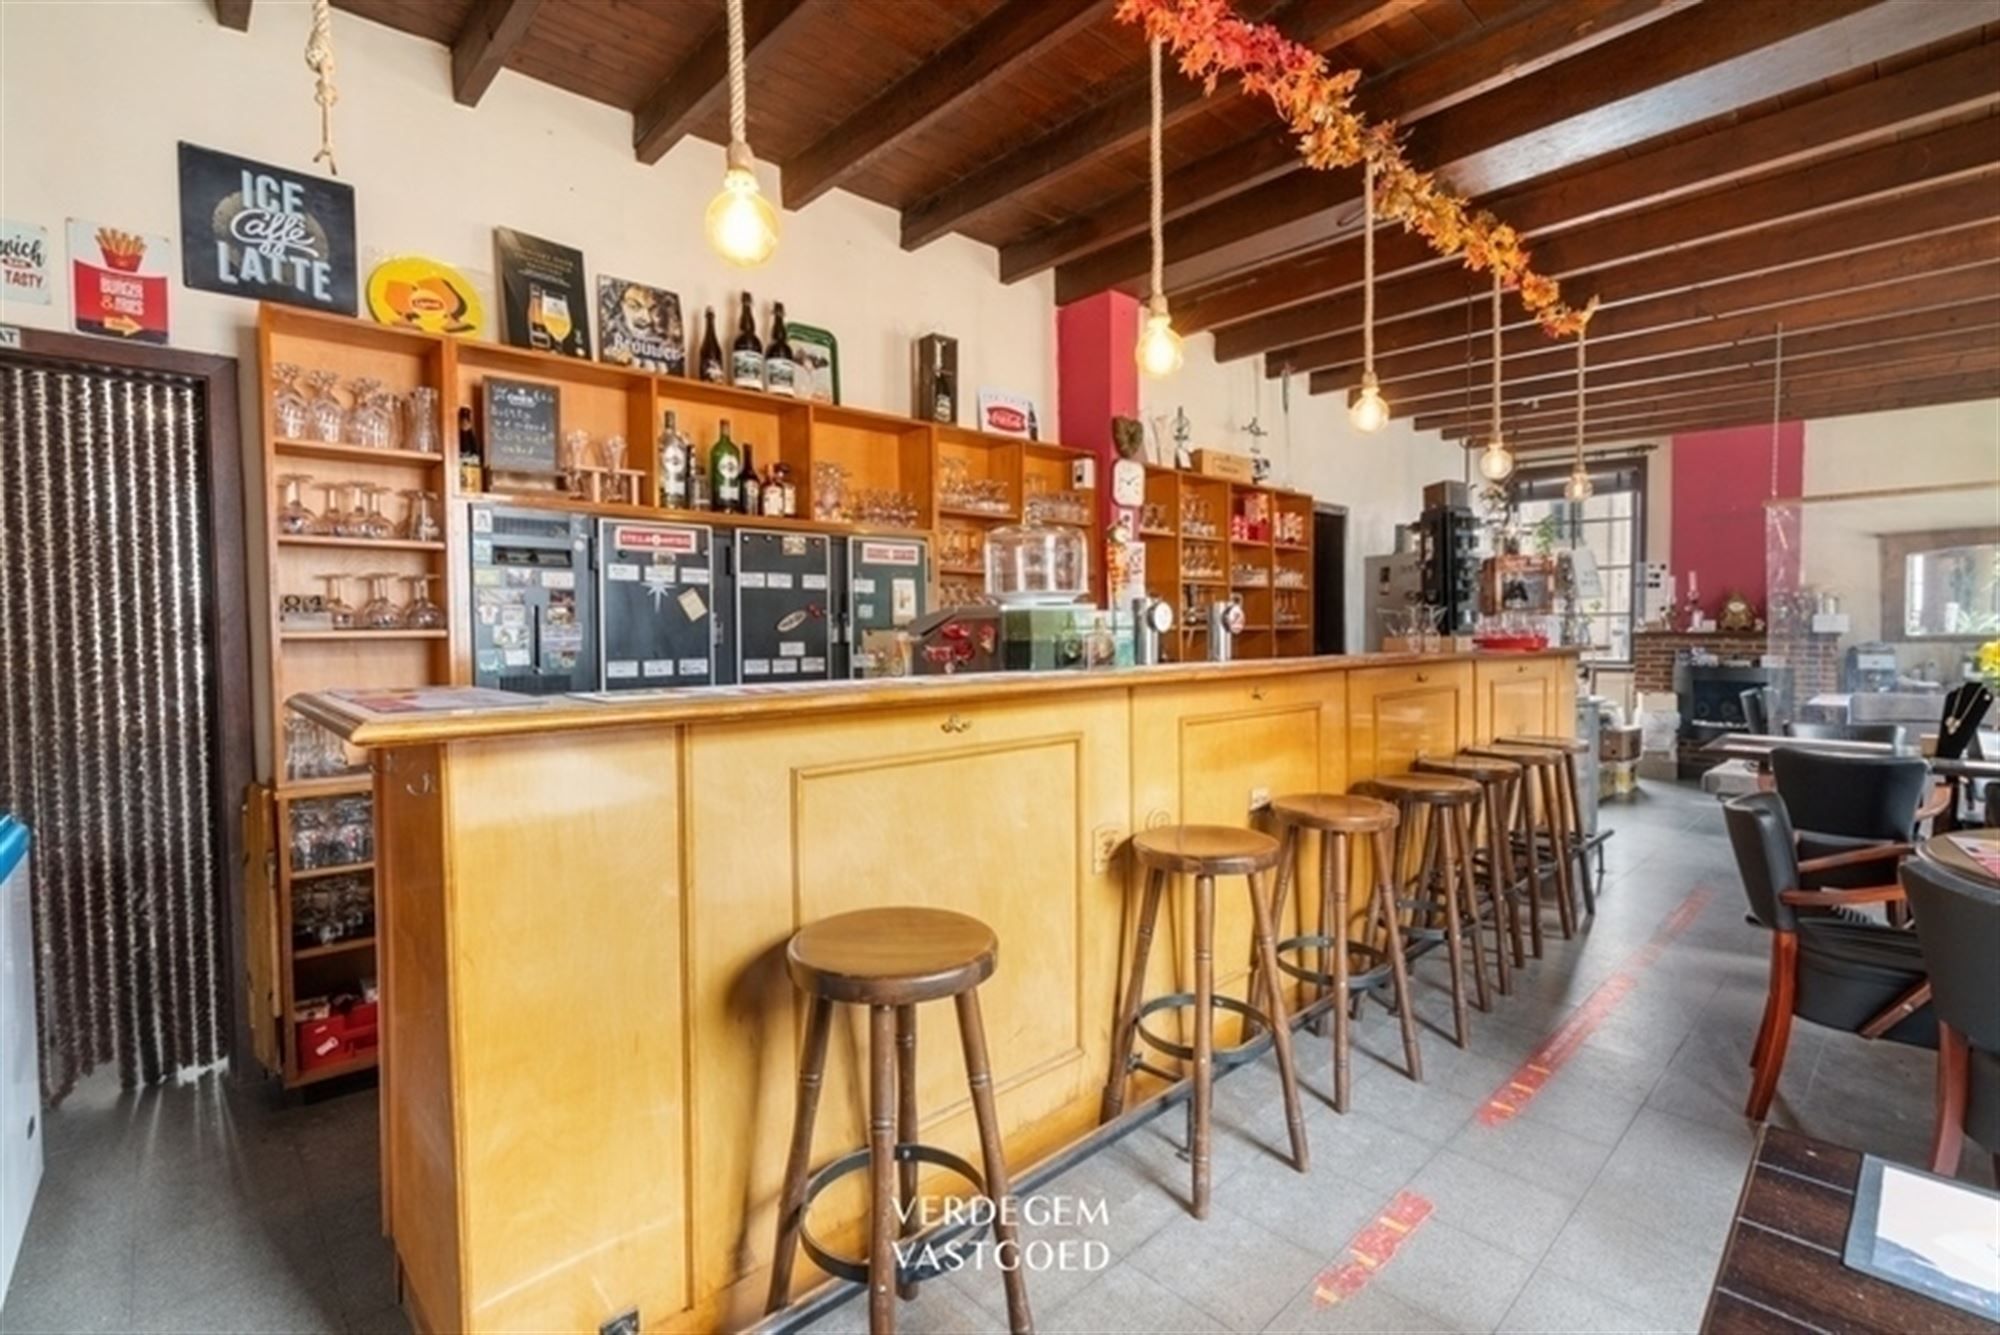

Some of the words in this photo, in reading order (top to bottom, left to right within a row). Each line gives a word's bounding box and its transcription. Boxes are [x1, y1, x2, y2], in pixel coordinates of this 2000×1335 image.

[242, 169, 304, 216] ICE
[5, 270, 43, 289] TASTY
[217, 240, 333, 302] LATTE
